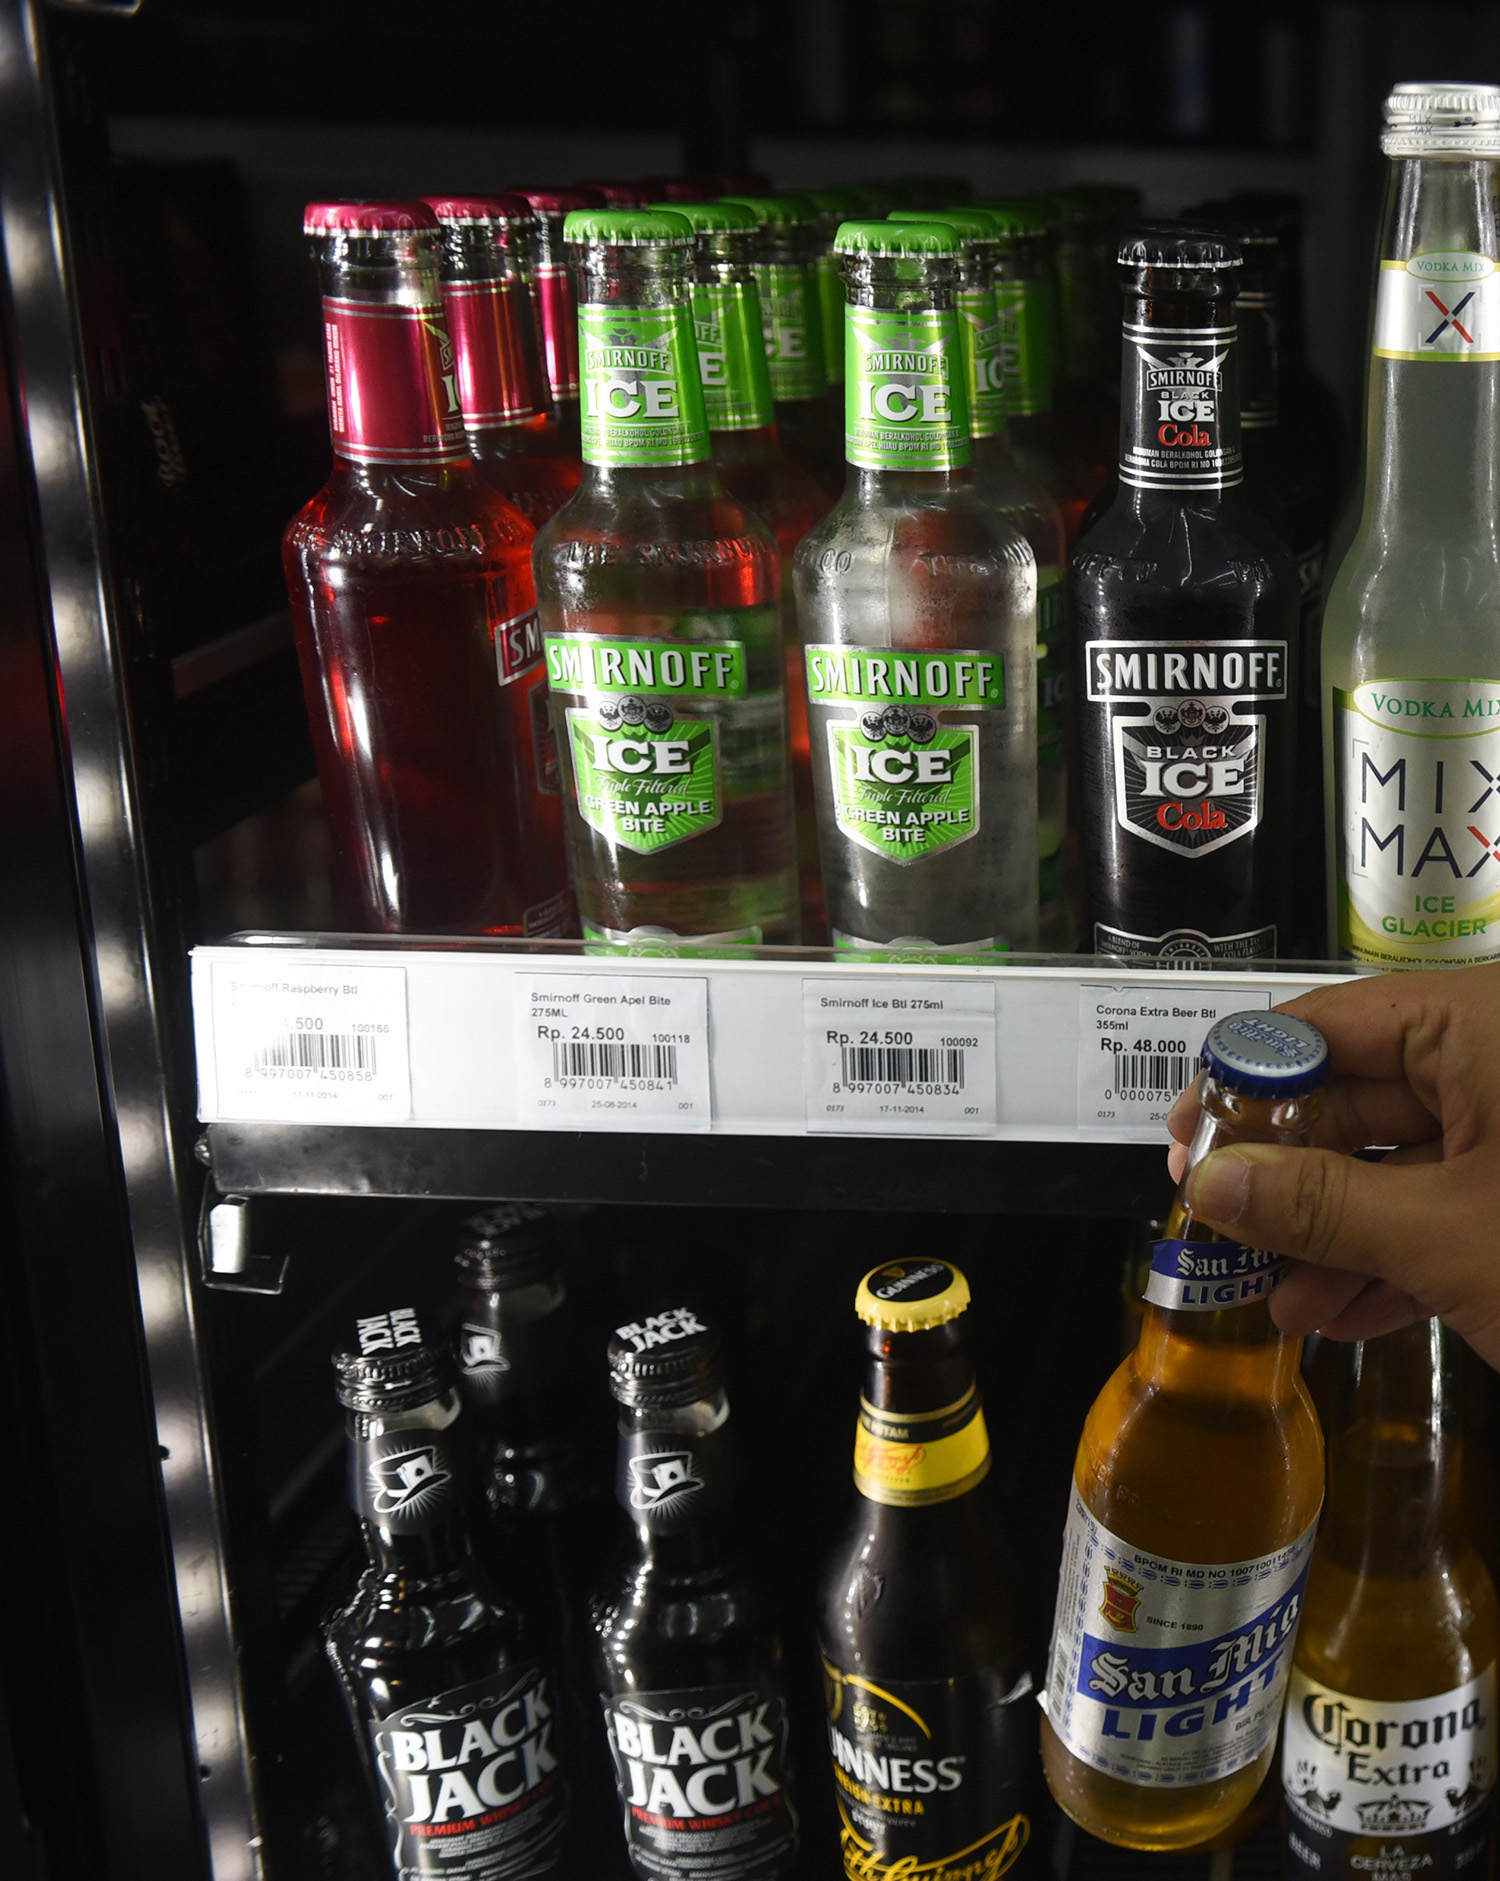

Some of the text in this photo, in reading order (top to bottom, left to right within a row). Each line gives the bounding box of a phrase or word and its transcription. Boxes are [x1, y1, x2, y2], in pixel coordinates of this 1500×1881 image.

[1417, 262, 1485, 272] VODKA MIX
[586, 349, 672, 374] SMIRNOFF
[865, 353, 946, 376] SMIRNOFF
[1150, 371, 1220, 387] SMIRNOFF
[584, 379, 680, 420] ICE
[857, 380, 952, 423] ICE
[1161, 391, 1210, 399] BLACK
[1157, 400, 1215, 423] ICE
[1157, 423, 1211, 447] Cola
[550, 644, 733, 690] SMIRNOFF
[811, 656, 994, 699] SMIRNOFF
[1096, 652, 1280, 691] SMIRNOFF
[1371, 693, 1455, 718] VODKA
[590, 733, 693, 776] ICE
[1147, 744, 1237, 759] BLACK
[853, 747, 954, 785] ICE
[1139, 761, 1245, 799] ICE
[584, 794, 712, 816] GREEN APPLE
[893, 787, 951, 806] Filtered
[622, 817, 667, 833] BITE
[845, 805, 970, 826] GREEN APPLE
[1156, 802, 1229, 831] Cola
[883, 827, 927, 843] BITE
[1415, 895, 1455, 914] ICE
[1382, 915, 1488, 938] GLACIER
[283, 983, 358, 996] Raspberry Btl
[531, 992, 671, 1006] Smirnoff Green Apel Bite
[531, 1008, 569, 1018] 275ML
[820, 998, 943, 1009] Smirnoff Ice Btl 275ml
[1096, 1005, 1216, 1019] Corona Extra Beer Btl
[538, 1026, 690, 1044] Rp. 24.500 100118
[1096, 1020, 1129, 1031] 355ml
[826, 1031, 979, 1047] Rp. 24.500 100092
[1101, 1038, 1186, 1055] Rp. 48.000
[848, 1083, 960, 1096] 997007 450834
[880, 1105, 924, 1114] 17-11-2014
[1097, 1111, 1116, 1119] 0173
[1176, 1248, 1229, 1277] San
[875, 1262, 945, 1300] GUINNESS
[1182, 1268, 1286, 1304] LIGHT
[356, 1313, 394, 1357] JACK
[614, 1306, 698, 1341] BLACK
[630, 1317, 709, 1355] JACK
[1134, 1554, 1227, 1579] BPOM MD NO
[1146, 1615, 1204, 1632] SINCE 1890
[1089, 1594, 1300, 1701] San Mig
[1101, 1652, 1284, 1741] LIGHT
[391, 1676, 552, 1772] BLACK
[613, 1700, 776, 1767] BLACK
[1303, 1694, 1481, 1755] Corona
[403, 1720, 559, 1824] JACK
[626, 1743, 781, 1819] JACK
[1347, 1752, 1449, 1786] Extra
